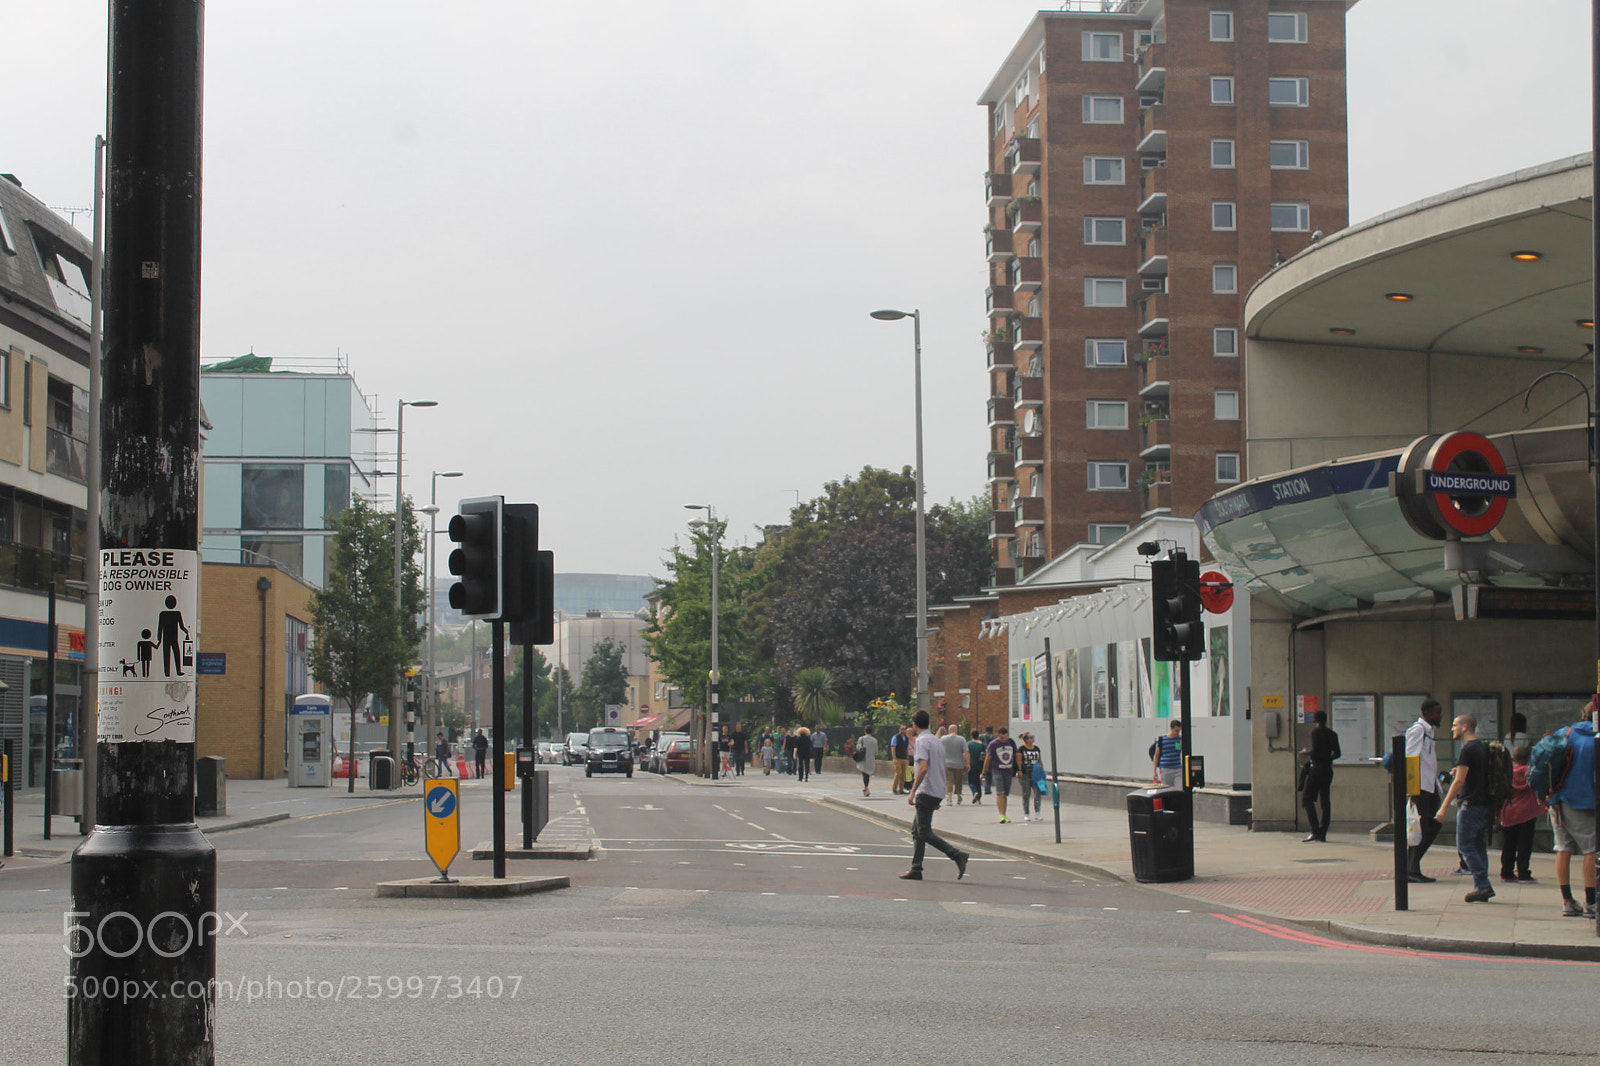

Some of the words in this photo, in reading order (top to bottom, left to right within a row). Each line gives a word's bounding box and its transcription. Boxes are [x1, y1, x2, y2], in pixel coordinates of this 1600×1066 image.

[1272, 478, 1311, 500] STATION
[1430, 475, 1511, 492] UNDERGROUND
[103, 552, 174, 567] PLEASE
[109, 569, 189, 580] RESPONSIBLE
[103, 581, 122, 591] DOG
[125, 581, 172, 591] OWNER
